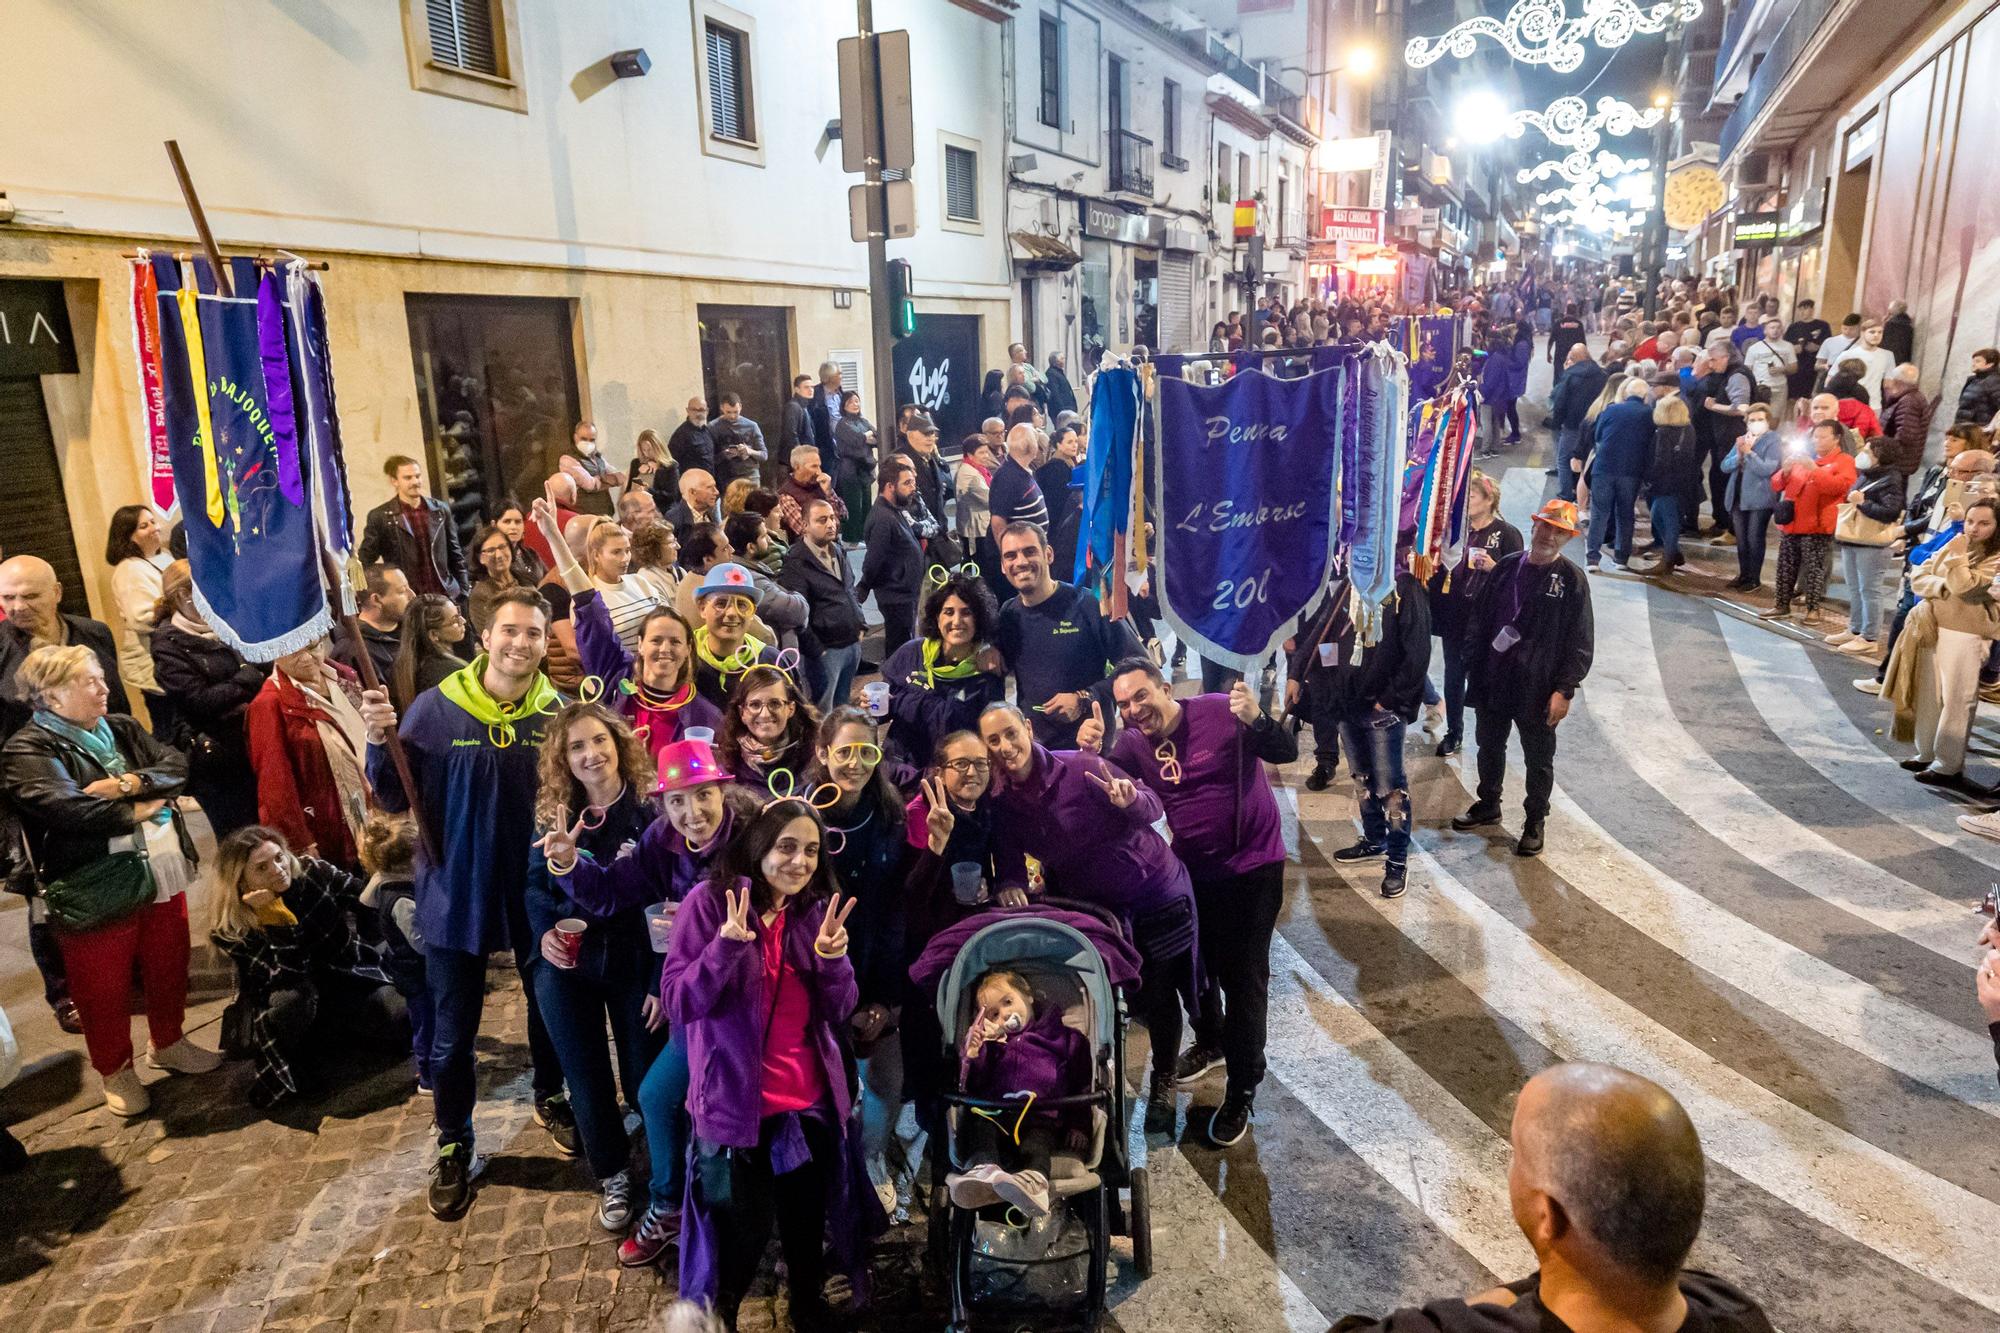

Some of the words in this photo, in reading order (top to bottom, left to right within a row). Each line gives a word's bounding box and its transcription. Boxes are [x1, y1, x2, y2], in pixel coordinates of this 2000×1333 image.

[1333, 209, 1348, 222] BEST
[1348, 210, 1372, 224] CHOICE
[1325, 225, 1377, 242] SUPERMARKET
[220, 376, 279, 458] BAJOQUE
